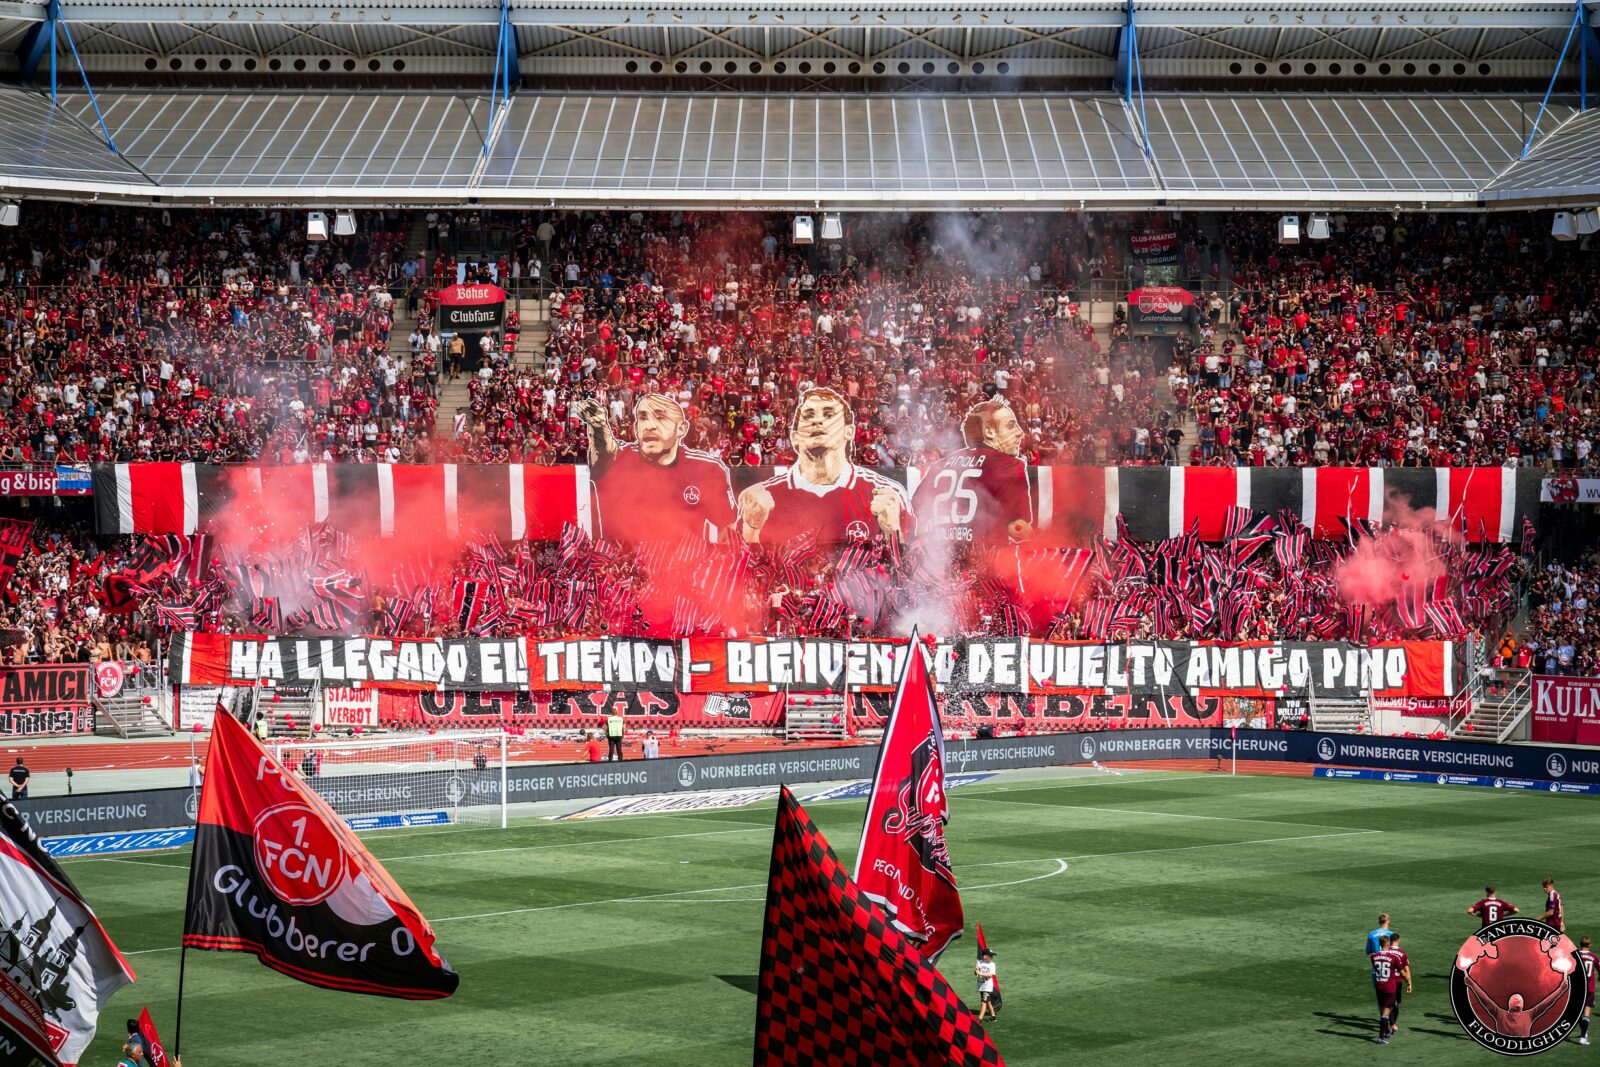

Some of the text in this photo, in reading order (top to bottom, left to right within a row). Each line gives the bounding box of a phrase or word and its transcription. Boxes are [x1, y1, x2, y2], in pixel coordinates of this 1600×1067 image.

[456, 287, 489, 300] Böhse
[450, 310, 495, 323] Clubfanz
[933, 469, 983, 524] 25
[231, 639, 284, 680] HA
[296, 639, 468, 683] LLEGADO
[479, 642, 528, 683] EL
[538, 641, 676, 684] TIEMPO
[968, 643, 1016, 685] DE
[1029, 642, 1173, 689] VUELTO
[1186, 646, 1309, 689] AMIGO
[1323, 648, 1408, 690] PINO
[3, 671, 86, 702] AMICI
[329, 706, 371, 724] VERBOT
[945, 744, 1055, 764] ERGER VERSICHERUNG
[1100, 737, 1288, 753] NÜRNBERGER VERSICHERUNG
[1340, 743, 1514, 768] NÜRNBERGER VERSICHERUNG
[700, 757, 860, 780] NÜRNBERGER VERSICHERUNG
[470, 771, 648, 795] NÜRBERGER VERSICHERUNG
[318, 786, 411, 803] ERSICHERUNG
[34, 804, 147, 825] VERSICHERUNG
[292, 816, 309, 848] 1.
[262, 839, 333, 889] FCN
[213, 864, 377, 962] Glubberer
[1488, 905, 1498, 922] 6
[1374, 961, 1391, 978] 36
